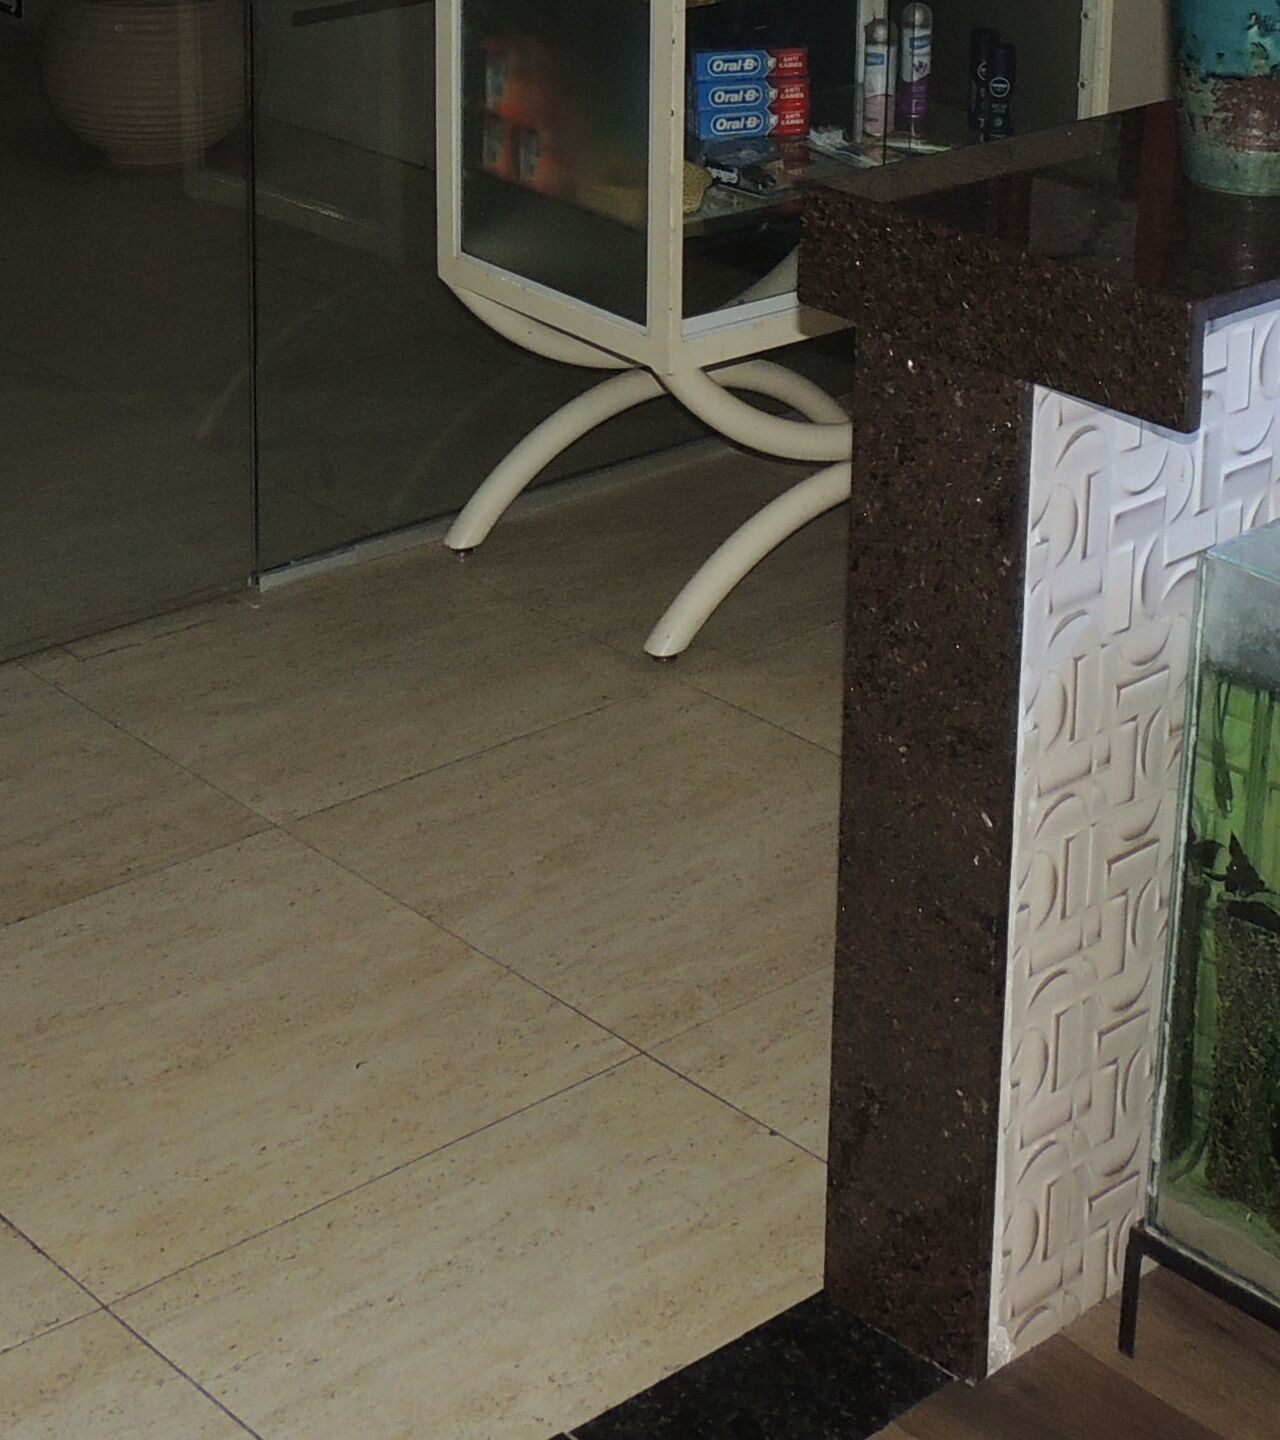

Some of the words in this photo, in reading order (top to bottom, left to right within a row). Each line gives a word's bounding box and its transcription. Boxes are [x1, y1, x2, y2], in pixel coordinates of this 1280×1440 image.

[712, 58, 757, 73] Oral-B
[713, 89, 759, 104] Oral-B
[715, 116, 761, 131] Oral-B
